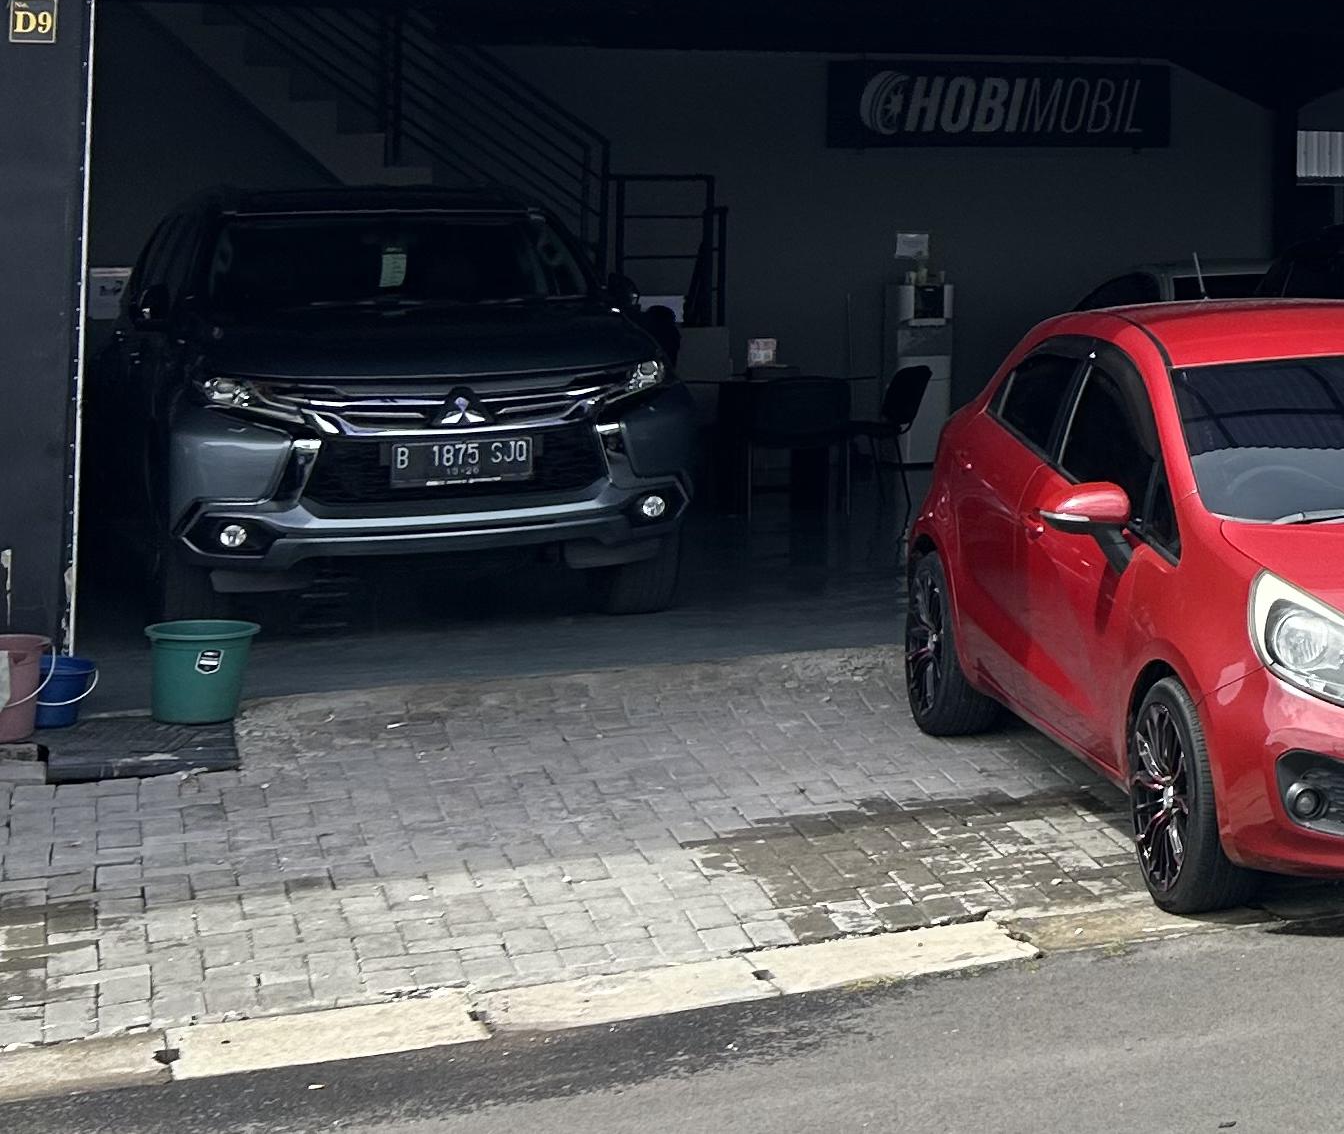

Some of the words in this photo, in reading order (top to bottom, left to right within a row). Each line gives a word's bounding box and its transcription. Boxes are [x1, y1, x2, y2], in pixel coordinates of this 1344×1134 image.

[13, 10, 53, 34] D9
[903, 74, 1145, 135] HOBIMOBIL
[396, 447, 410, 470] B
[431, 443, 481, 467] 1875
